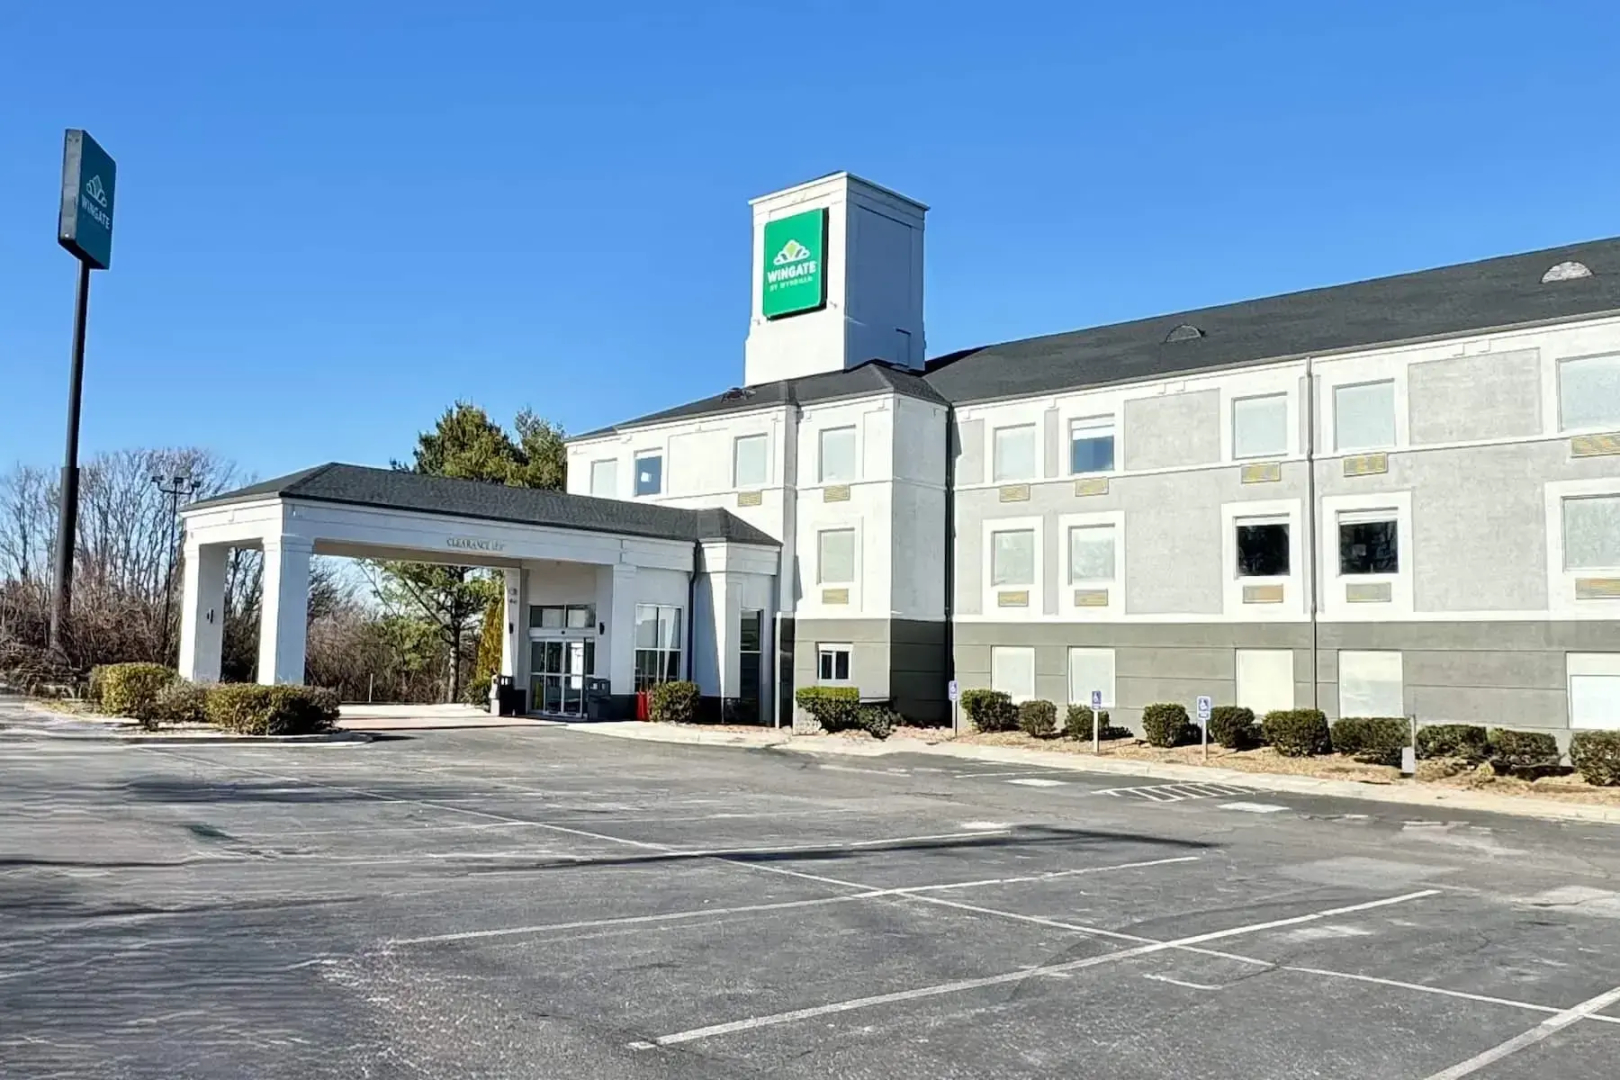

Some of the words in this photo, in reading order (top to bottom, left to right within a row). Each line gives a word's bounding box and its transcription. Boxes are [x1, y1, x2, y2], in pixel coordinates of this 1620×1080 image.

[81, 193, 111, 230] WINGATE
[767, 261, 817, 284] WINGATE
[769, 283, 778, 292] BY
[446, 538, 490, 551] CLEARANCE
